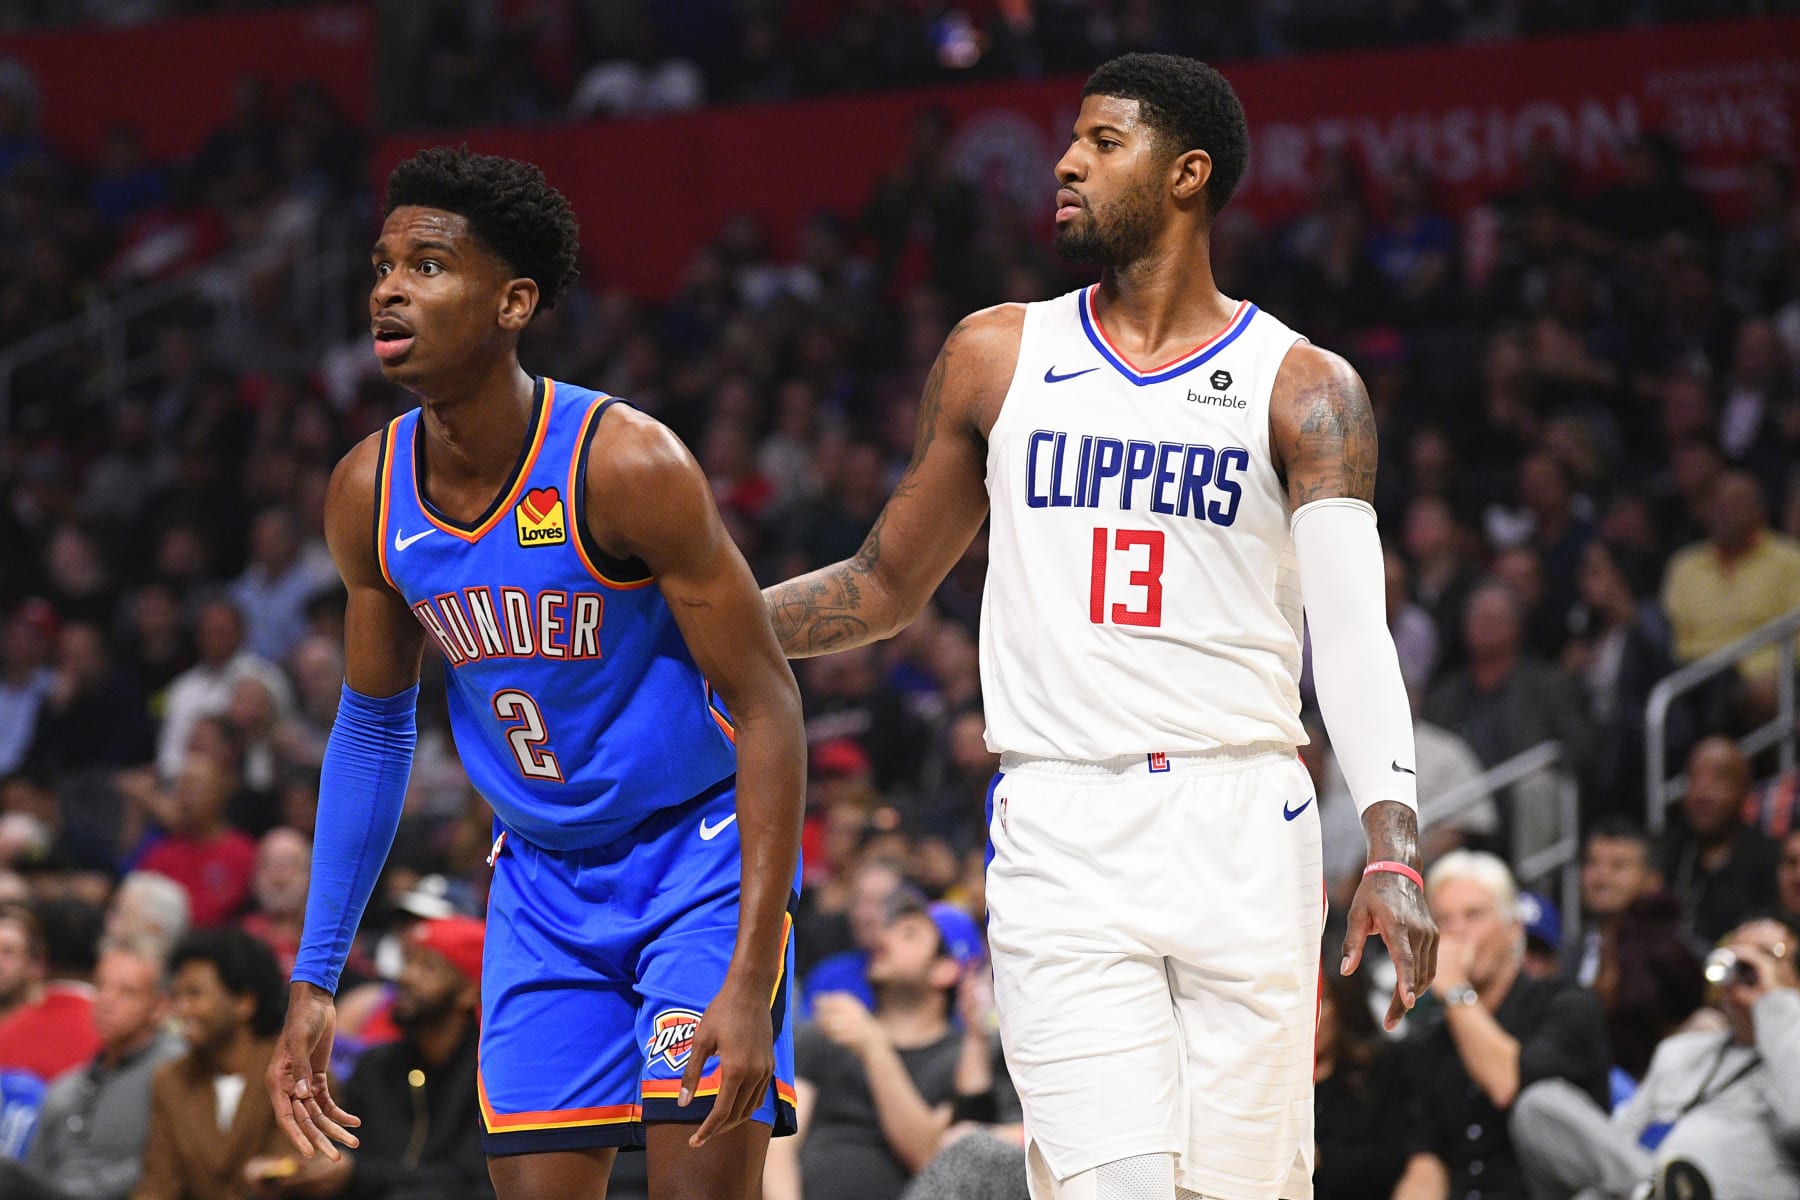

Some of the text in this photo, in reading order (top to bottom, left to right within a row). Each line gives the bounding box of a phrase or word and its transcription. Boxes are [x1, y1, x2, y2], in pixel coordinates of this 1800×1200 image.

[1187, 389, 1247, 409] bumble
[1025, 429, 1249, 527] CLIPPERS
[1090, 527, 1165, 627] 13
[411, 586, 604, 669] HUNDER
[491, 688, 565, 783] 2
[650, 1022, 697, 1057] OKC
